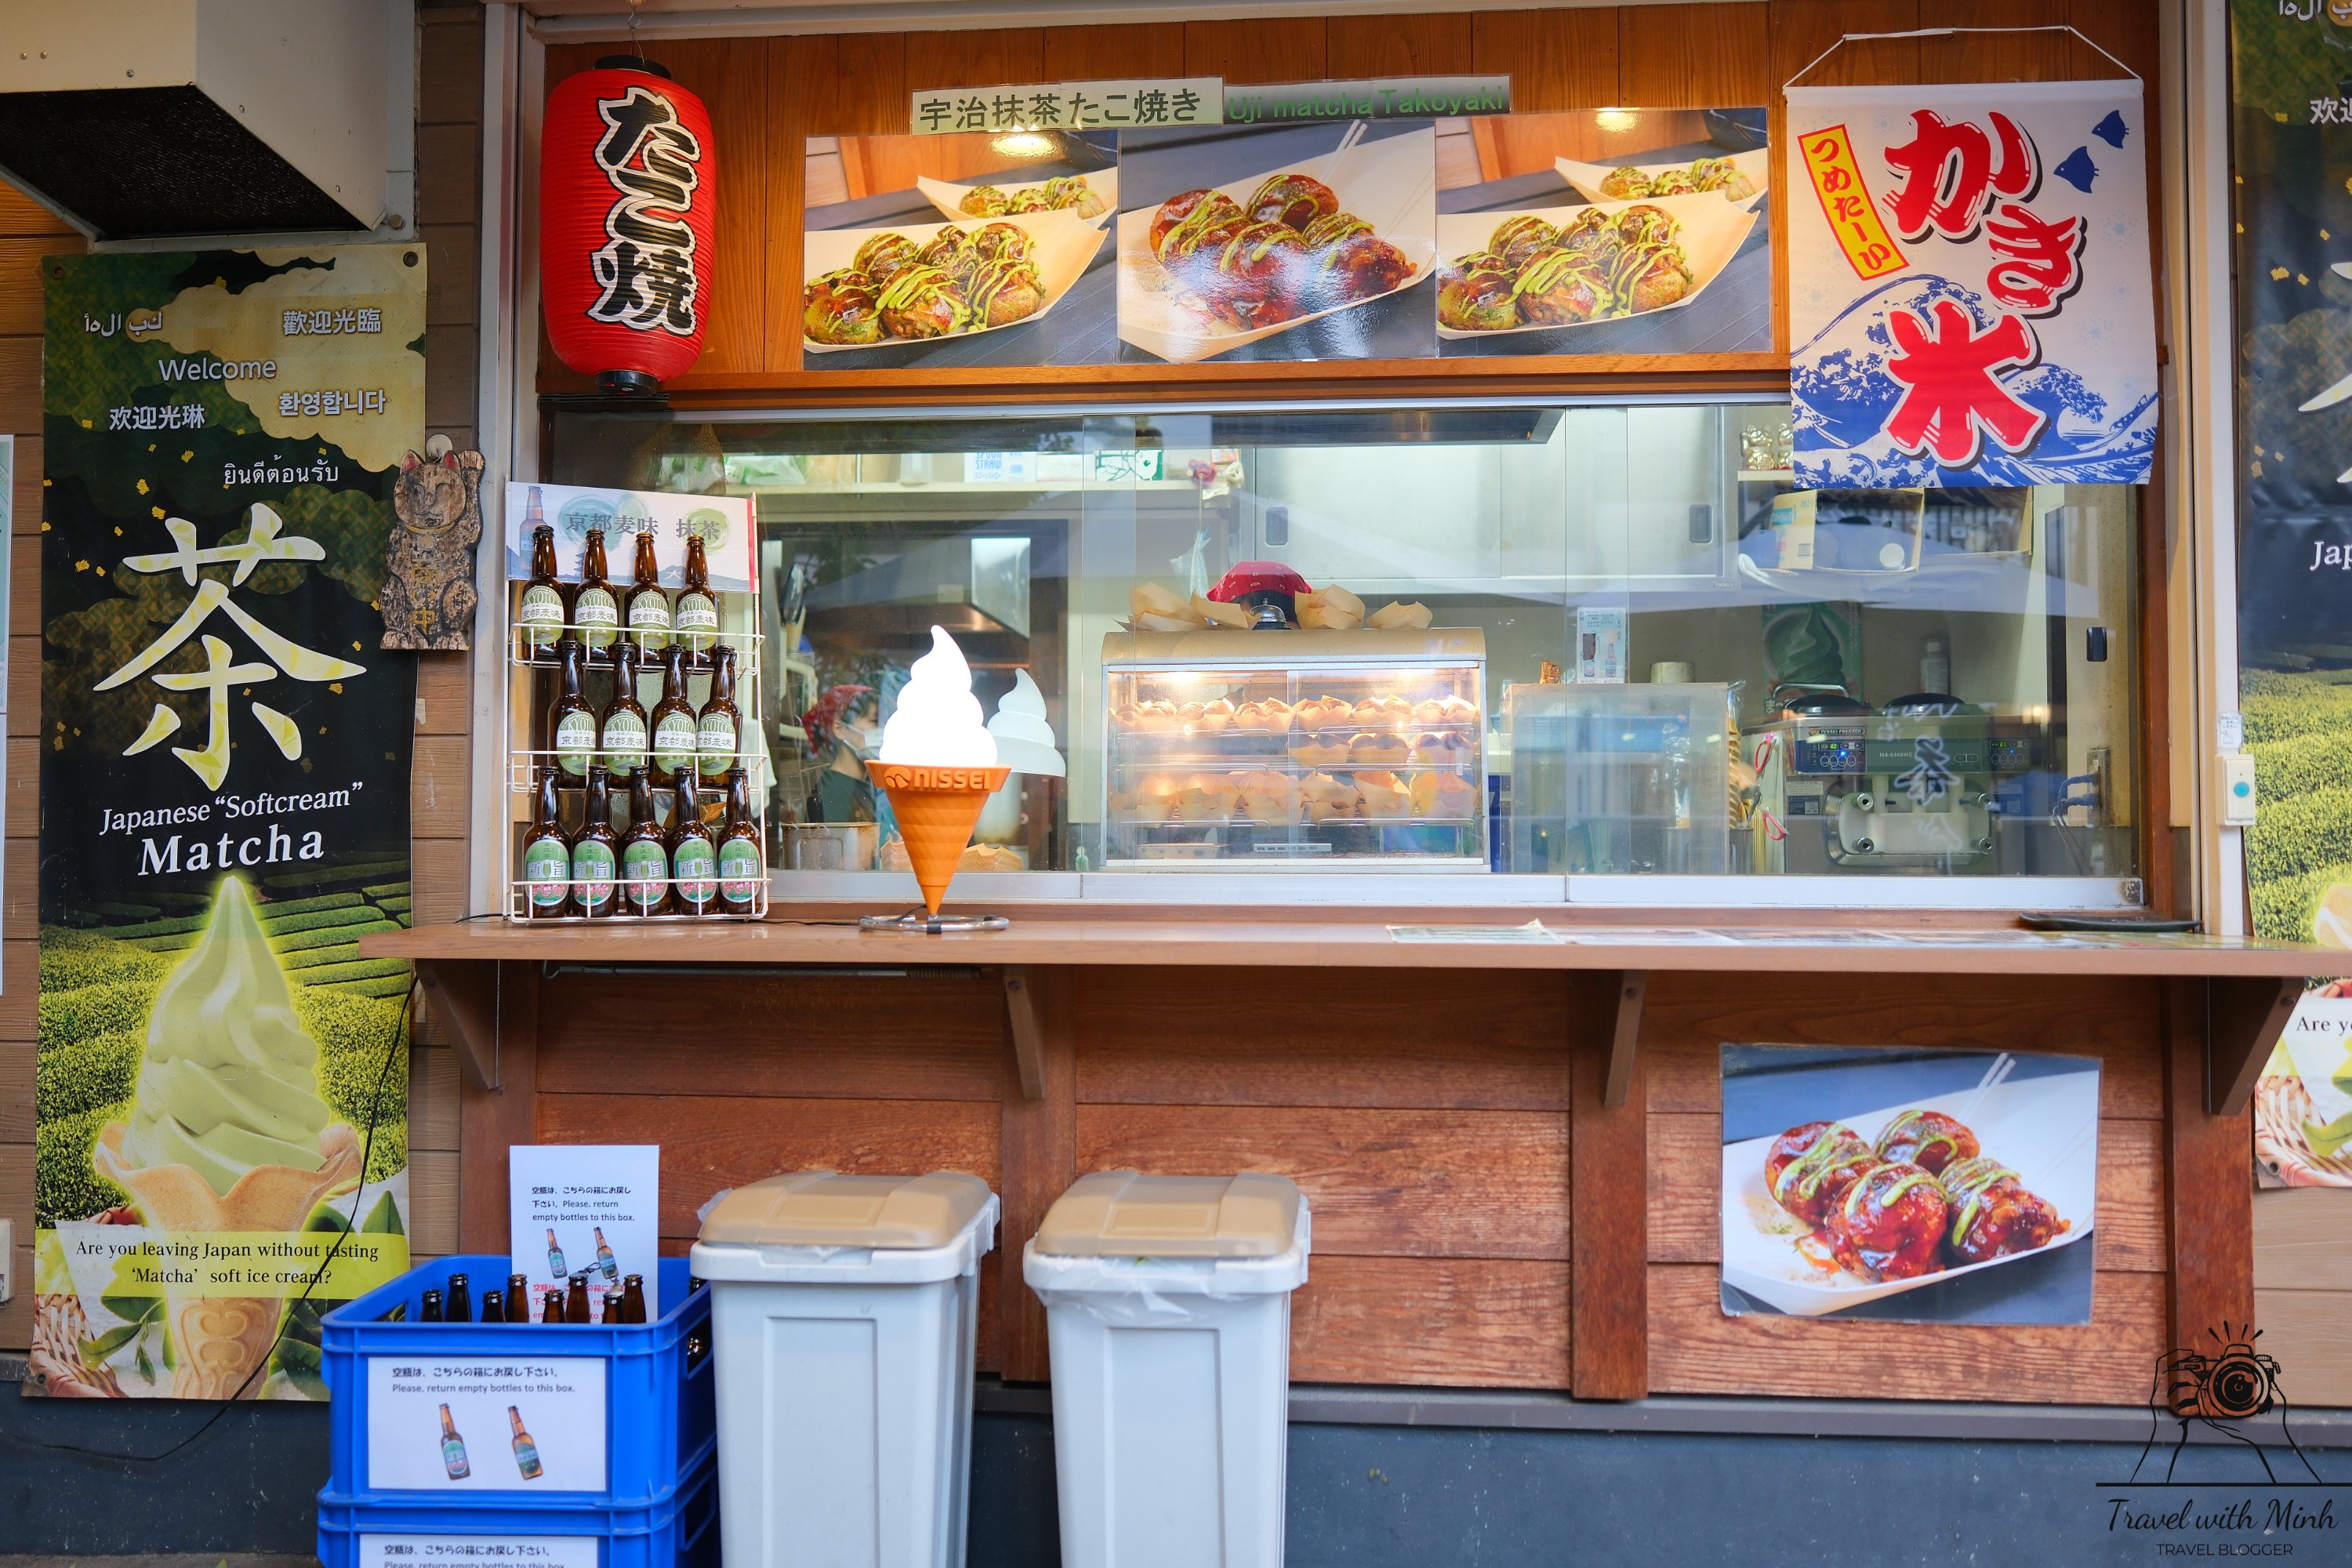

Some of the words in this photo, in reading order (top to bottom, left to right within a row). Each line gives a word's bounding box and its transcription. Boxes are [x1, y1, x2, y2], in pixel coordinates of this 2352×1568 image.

[920, 88, 1202, 131] 宇治抹茶たこ焼き
[1229, 96, 1263, 125] Uji
[1273, 95, 1372, 119] matcha
[1378, 89, 1504, 117] Takoyaki
[586, 85, 701, 338] たこ焼
[1810, 137, 1892, 271] つめたーい
[1882, 108, 2087, 470] かき氷
[283, 308, 382, 336] 歡迎光臨
[158, 358, 277, 382] Welcome
[278, 389, 387, 417] 환영합니다
[109, 404, 205, 431] 欢迎光琳
[224, 454, 339, 485] ยินดีต้อนรับ
[975, 459, 1002, 469] STRAW
[565, 512, 659, 536] 京都麦味
[675, 518, 720, 541] 抹茶
[527, 590, 555, 604] KYOTO
[582, 593, 610, 607] KYOTO
[637, 596, 664, 610] KYOTO
[681, 598, 708, 612] KYOTO
[93, 502, 367, 791] 茶
[568, 717, 595, 731] KYOTO
[611, 717, 640, 731] KYOTO
[666, 718, 691, 733] KYOTO
[701, 719, 728, 733] KYOTO
[914, 770, 990, 789] NISSEI
[99, 800, 211, 836] Japanese
[137, 824, 325, 876] Matcha
[2296, 1016, 2330, 1032] Are
[2338, 1021, 2352, 1036] y
[76, 1240, 104, 1257] Are
[108, 1243, 137, 1261] you
[142, 1240, 198, 1261] leaving
[202, 1241, 251, 1261] Japan
[256, 1242, 320, 1258] without
[326, 1243, 379, 1262] tasting
[210, 1268, 241, 1283] soft
[247, 1268, 270, 1283] ice
[275, 1269, 332, 1286] cream?
[459, 1385, 487, 1394] empty
[490, 1384, 522, 1392] bottles
